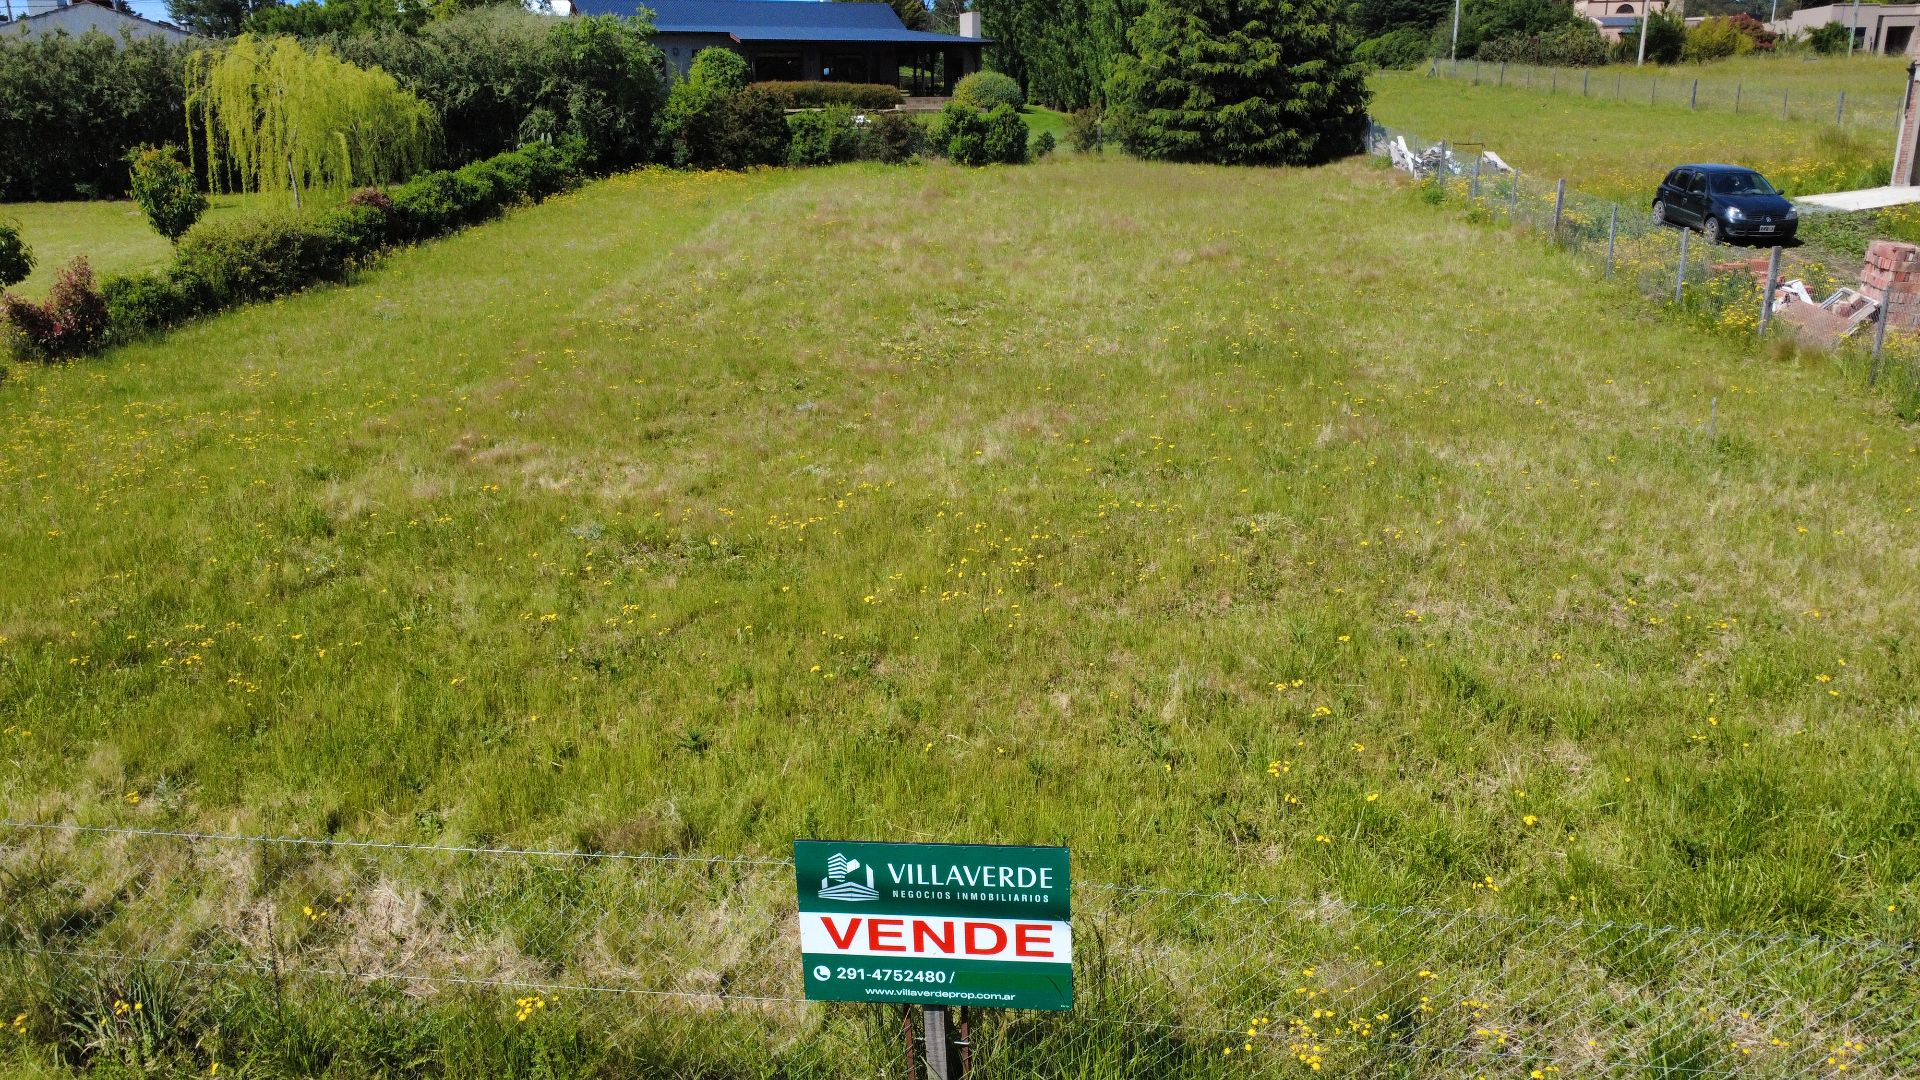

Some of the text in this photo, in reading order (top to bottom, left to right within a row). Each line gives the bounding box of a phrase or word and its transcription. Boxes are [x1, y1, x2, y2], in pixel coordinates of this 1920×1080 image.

[887, 863, 1053, 889] VILLAVERDE
[892, 890, 1049, 903] NEGOCIOS INMOBILIARIOS
[820, 916, 1055, 958] VENDE
[836, 967, 946, 983] 291-4752480
[865, 987, 1016, 1001] www.villaverdeprop.com.ar
